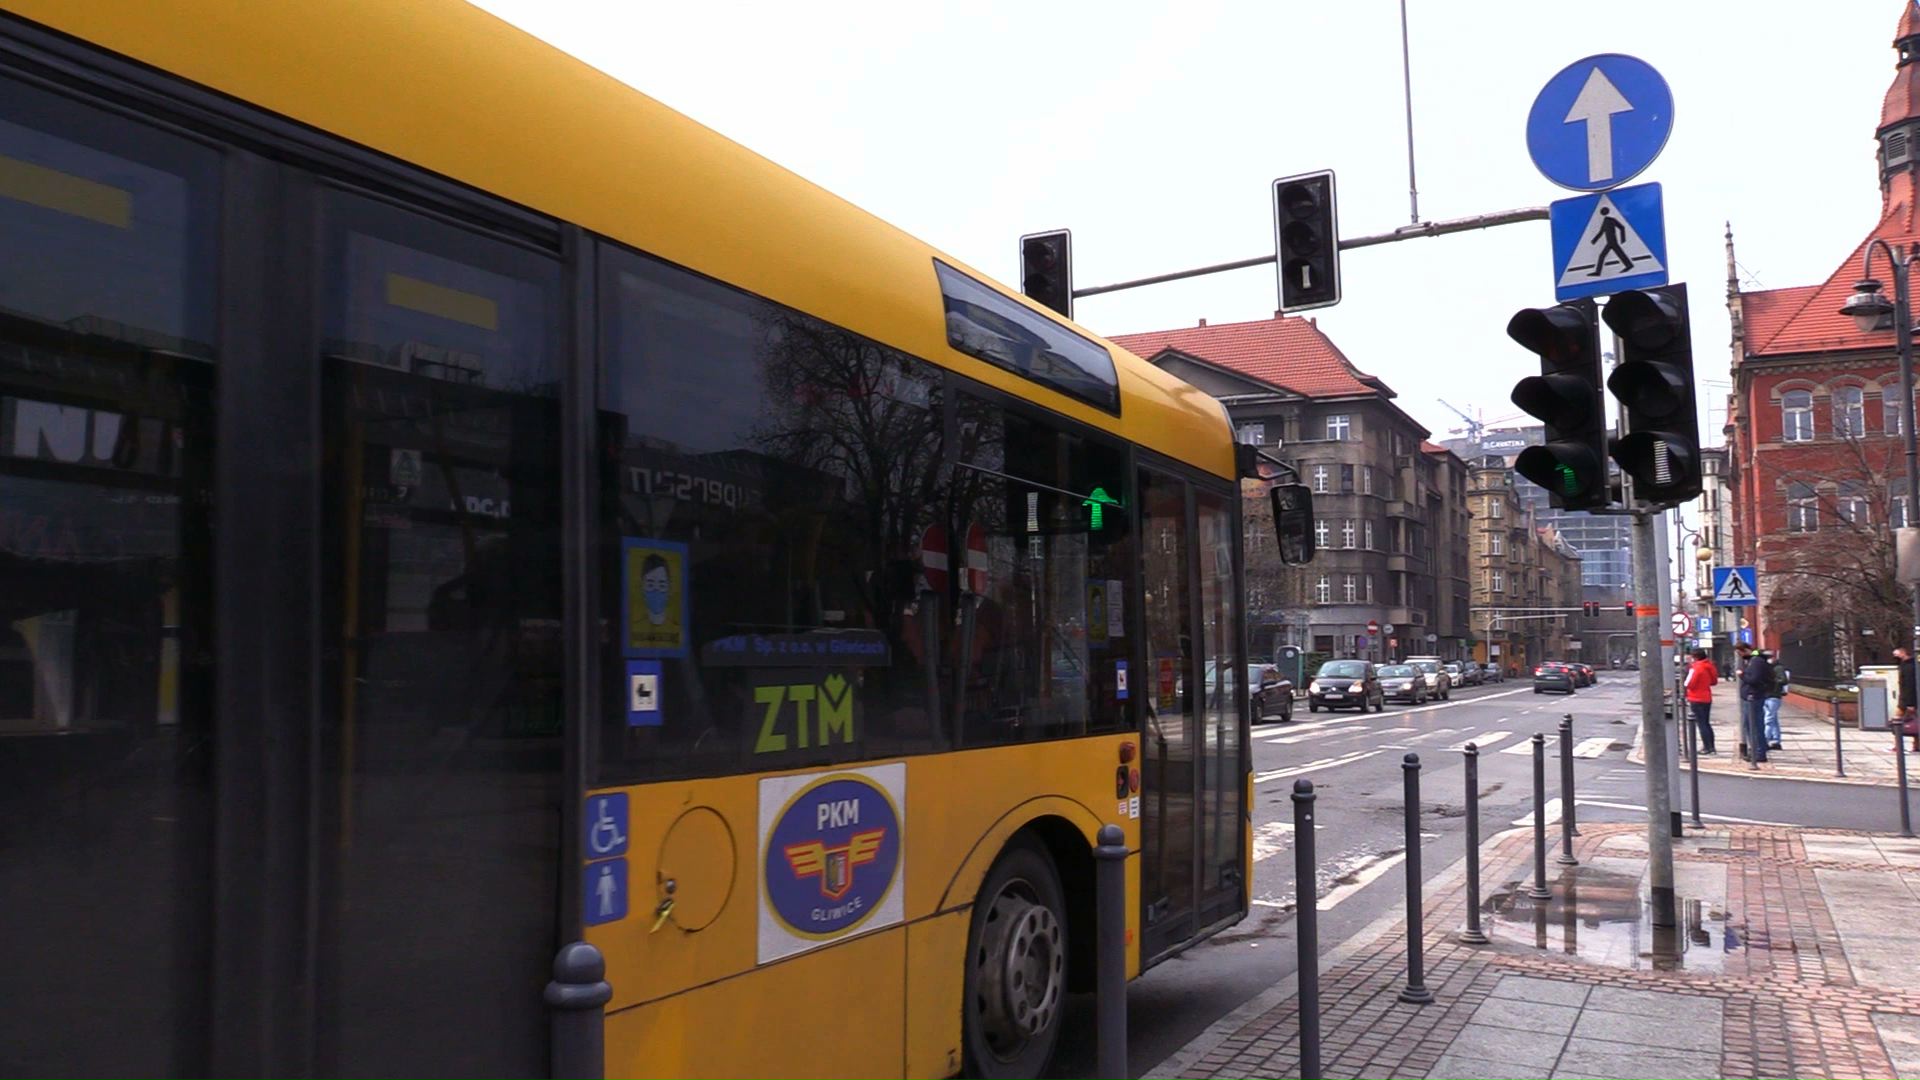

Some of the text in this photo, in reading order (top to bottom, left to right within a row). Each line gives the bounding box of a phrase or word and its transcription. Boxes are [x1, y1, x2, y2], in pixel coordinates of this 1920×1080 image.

[754, 673, 854, 754] ZTM
[817, 798, 860, 831] PKM
[811, 896, 863, 921] GLIWICE
